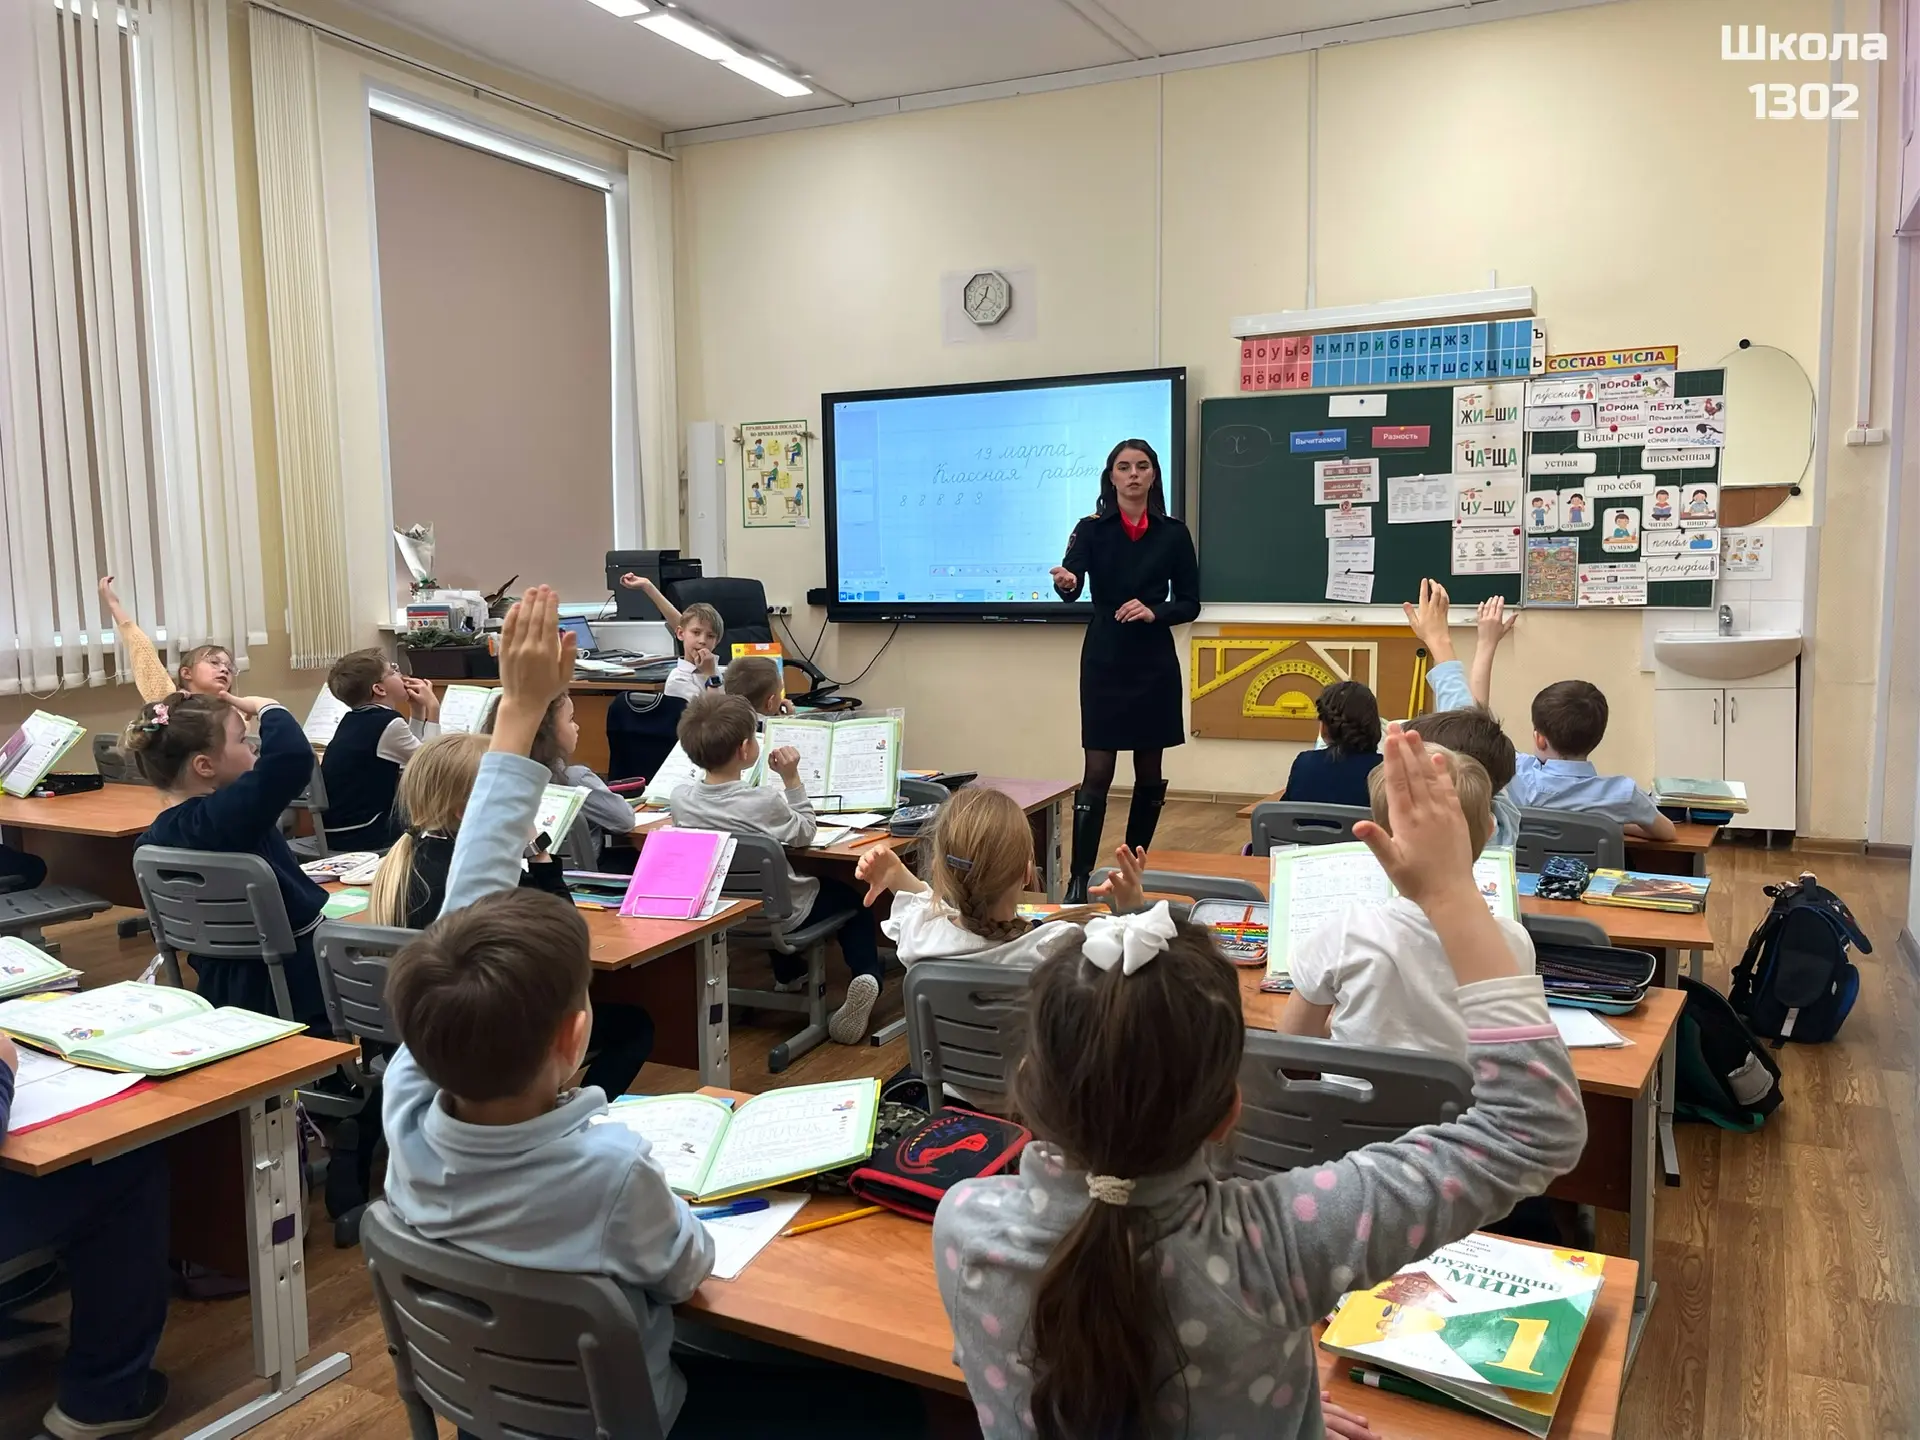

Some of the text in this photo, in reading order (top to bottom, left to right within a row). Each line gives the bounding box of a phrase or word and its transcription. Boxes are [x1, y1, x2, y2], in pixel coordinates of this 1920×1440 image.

[1548, 350, 1666, 370] СОСТАВ ЧИСЛА
[1295, 436, 1342, 446] Вычитаемое
[1383, 433, 1419, 441] Разность
[1583, 431, 1644, 445] Виды речи
[998, 443, 1075, 468] марта
[1646, 452, 1711, 464] письменная
[1544, 459, 1579, 469] устная
[1596, 480, 1642, 494] про себя
[1446, 1268, 1531, 1298] МИР
[1485, 1317, 1550, 1376] 1
